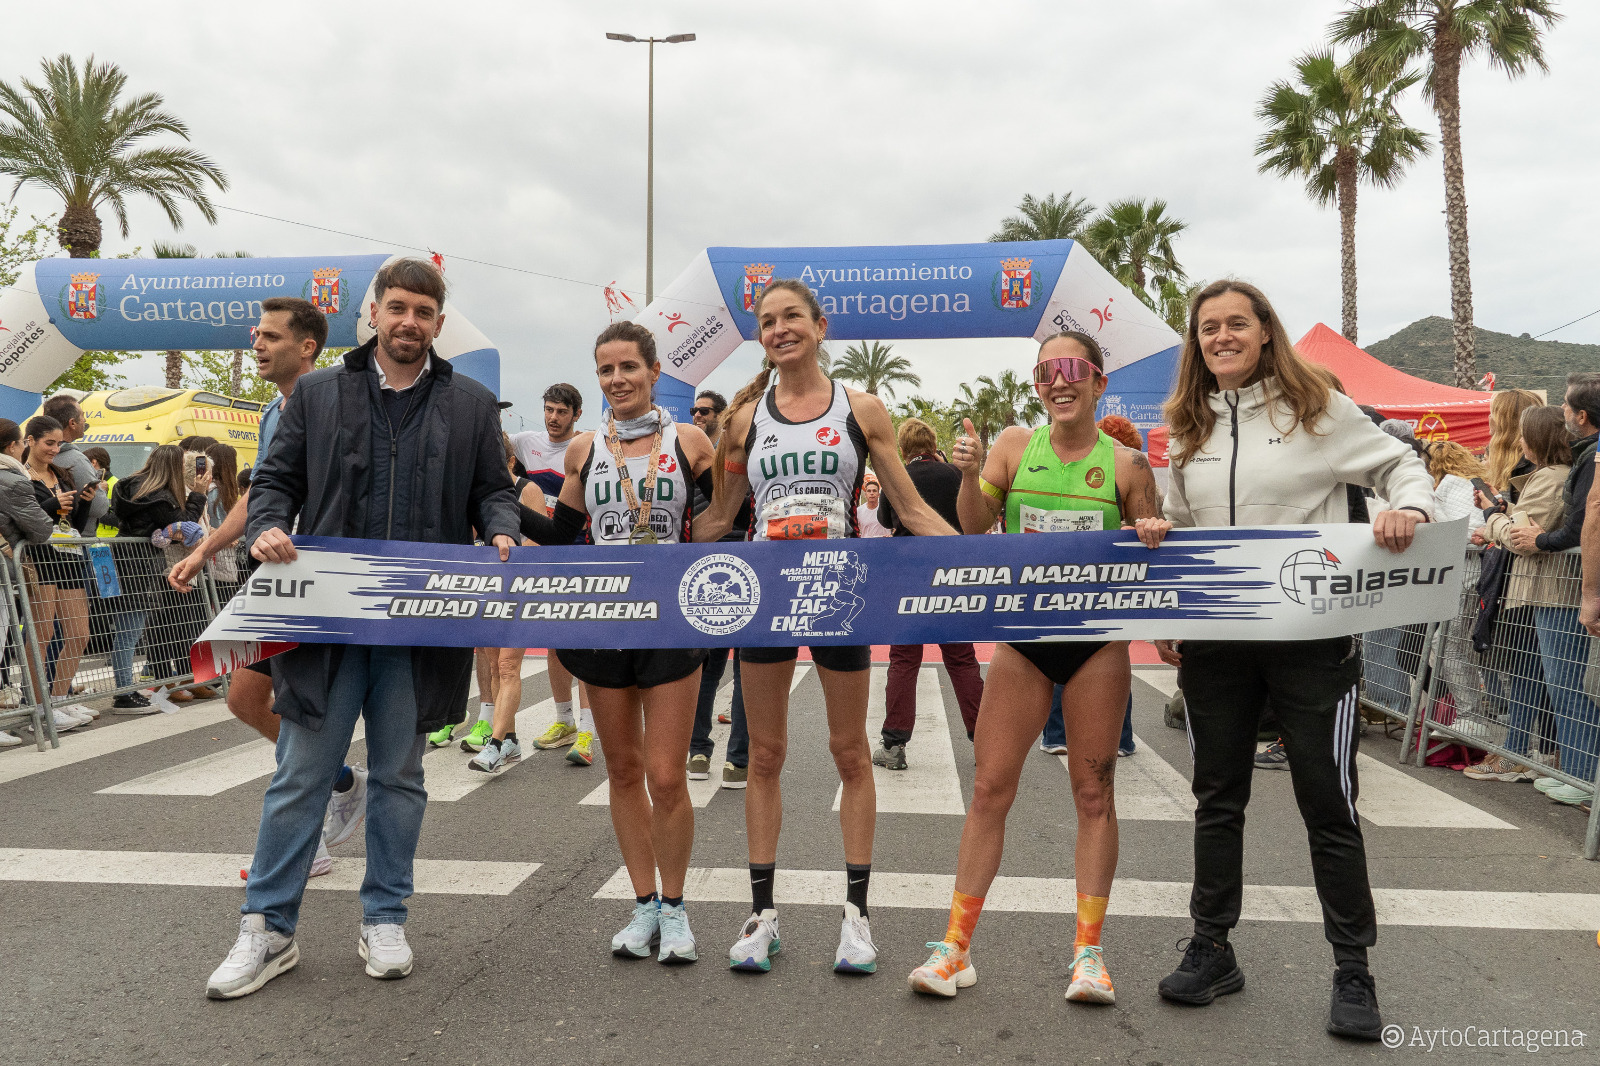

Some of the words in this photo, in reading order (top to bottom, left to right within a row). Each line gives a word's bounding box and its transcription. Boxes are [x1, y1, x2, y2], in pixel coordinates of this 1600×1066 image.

[119, 272, 285, 295] Ayuntamiento
[800, 263, 973, 288] Ayuntamiento
[119, 295, 264, 327] Cartagen
[808, 288, 972, 321] artagena
[25, 320, 36, 331] de
[705, 315, 717, 326] de
[672, 321, 724, 368] Deportes
[228, 429, 258, 441] SOPORTE
[760, 450, 839, 481] UNED
[805, 486, 832, 495] CABEZO
[781, 522, 815, 538] 136
[802, 550, 849, 567] MEDIA
[101, 565, 112, 585] B
[680, 580, 688, 604] CLUB
[686, 555, 735, 577] DEPORTIVO
[739, 560, 759, 604] TRIATLON
[780, 567, 824, 576] MARATON
[931, 566, 1012, 586] MEDIA
[1019, 563, 1148, 584] MARATON
[1300, 565, 1454, 596] Talasur
[425, 573, 503, 593] MEDIA
[509, 575, 632, 594] MARATON
[797, 581, 839, 597] CAR
[389, 598, 479, 618] CIUDAD
[482, 601, 518, 619] DE
[521, 601, 659, 620] CARTAGENA
[686, 606, 724, 615] SANTA
[728, 606, 752, 615] ANA
[790, 598, 828, 615] TAG
[897, 594, 988, 615] CIUDAD
[993, 593, 1028, 613] DE
[1033, 590, 1179, 612] CARTAGENA
[1311, 591, 1384, 615] group
[692, 619, 747, 635] CARTAGENA
[770, 615, 811, 631] ENA
